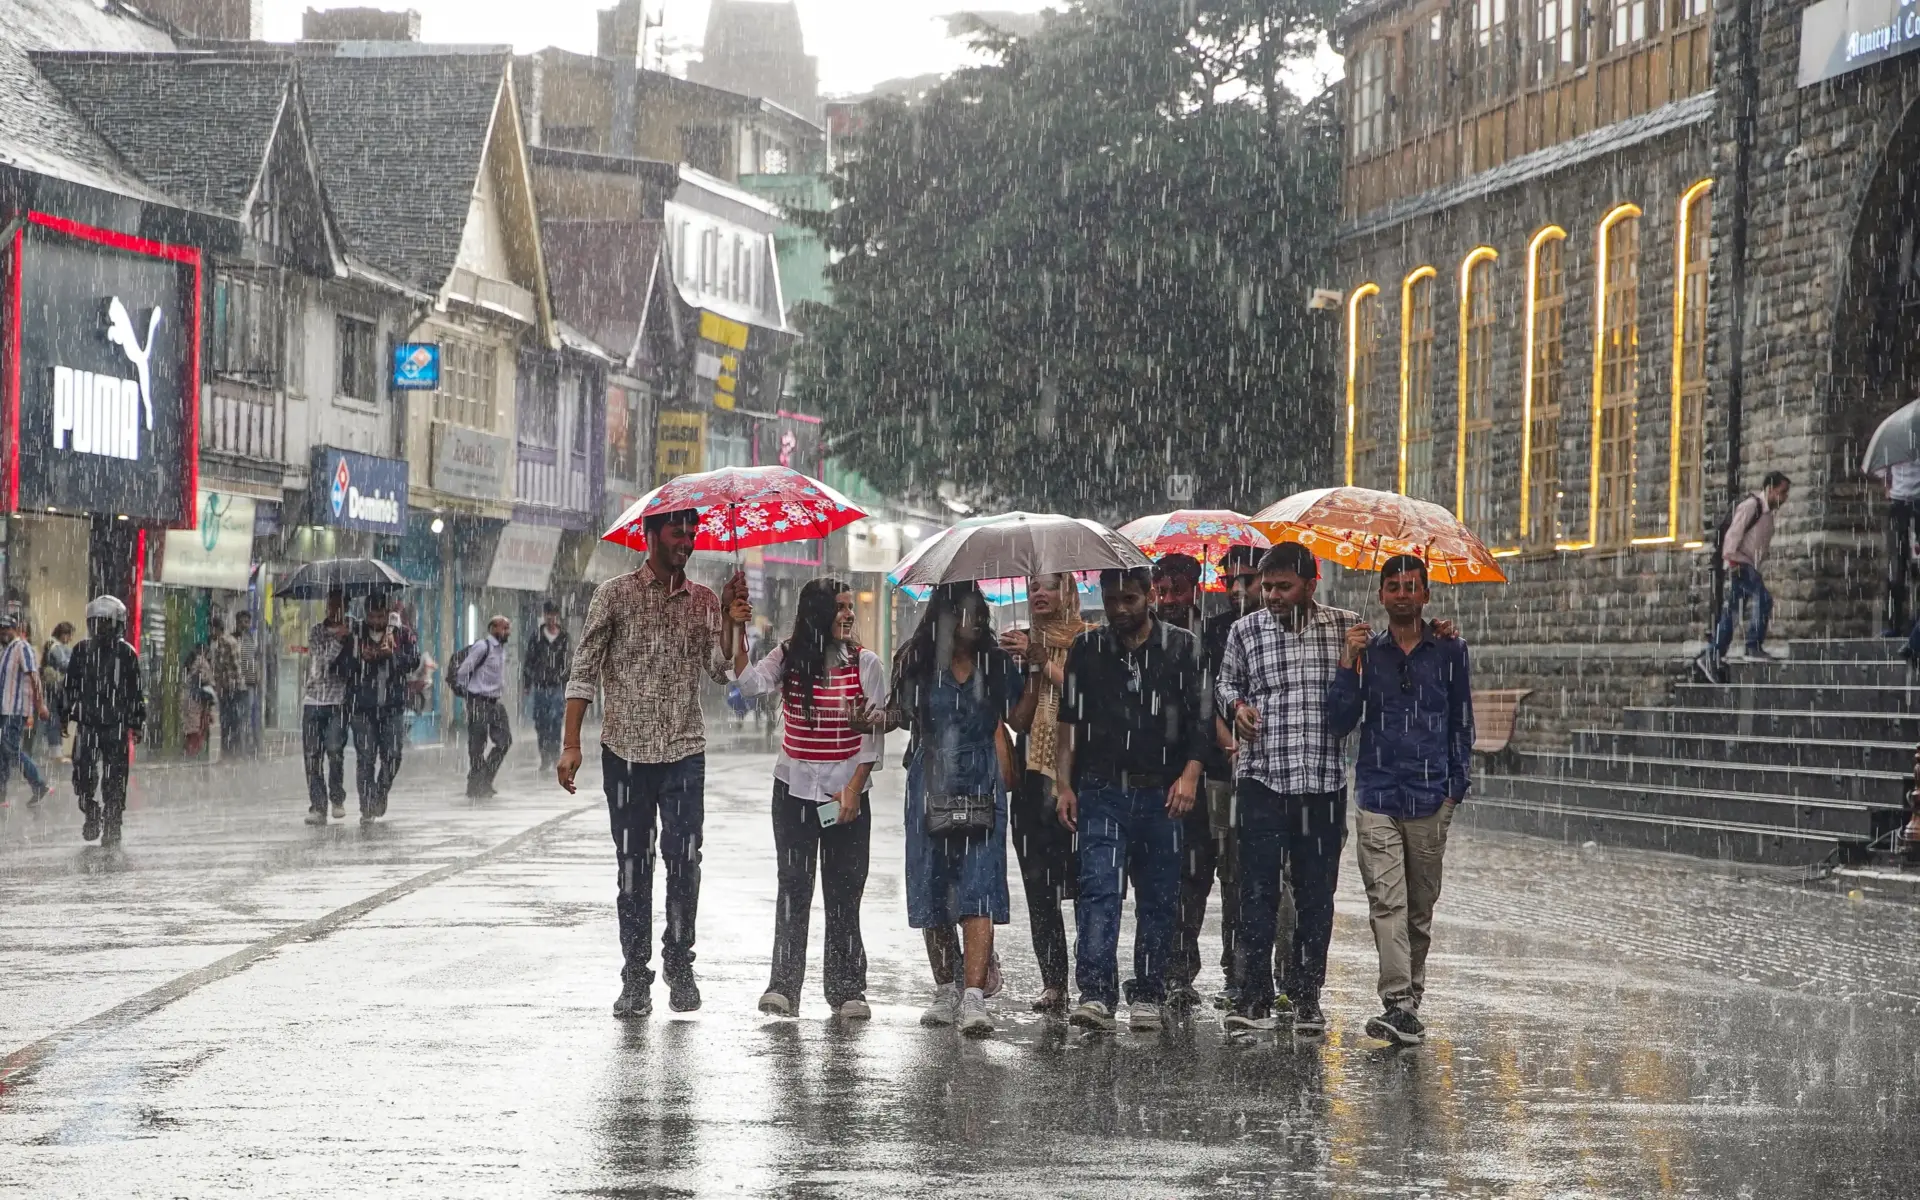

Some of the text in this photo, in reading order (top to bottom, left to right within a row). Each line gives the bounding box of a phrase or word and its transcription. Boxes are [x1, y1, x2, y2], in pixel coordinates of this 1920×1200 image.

[1845, 15, 1902, 62] Municipal
[53, 365, 139, 461] PUMA
[349, 486, 399, 524] Domino's
